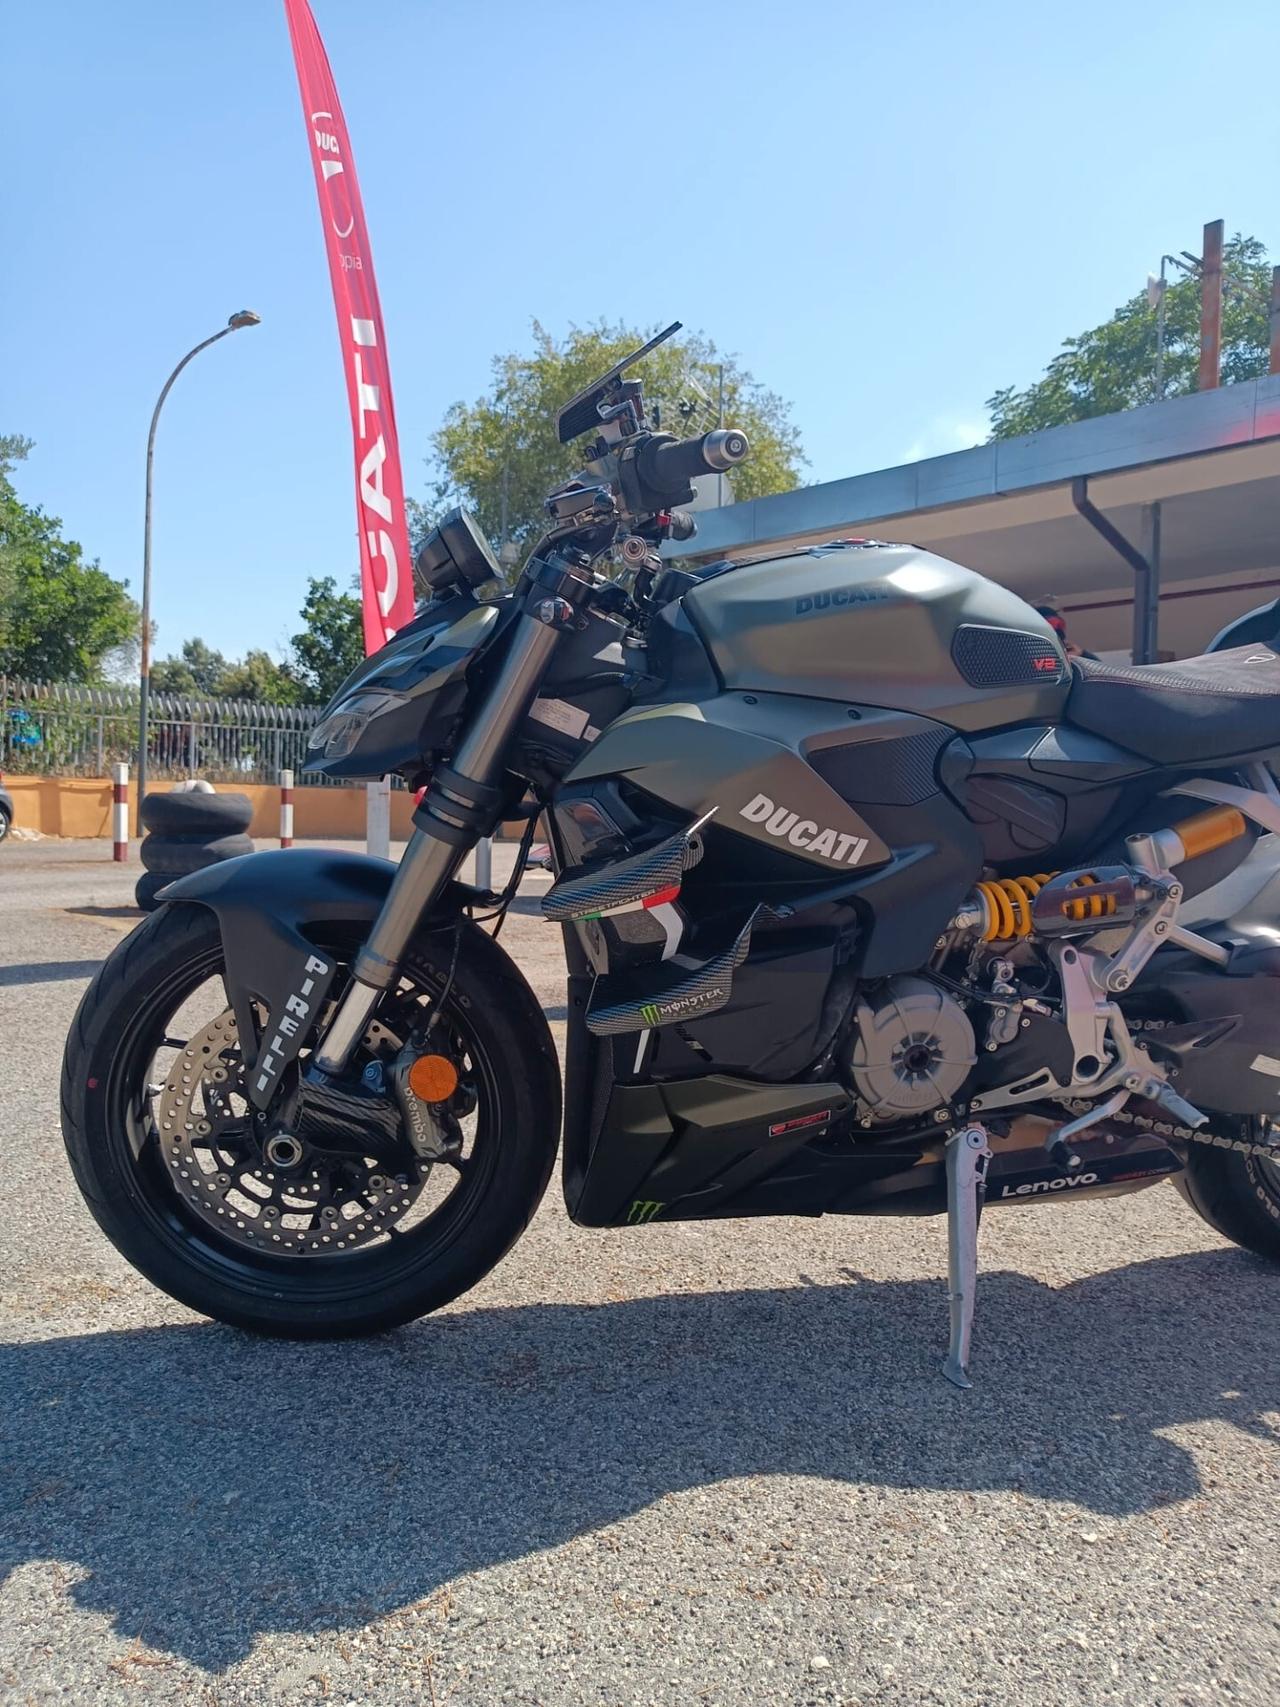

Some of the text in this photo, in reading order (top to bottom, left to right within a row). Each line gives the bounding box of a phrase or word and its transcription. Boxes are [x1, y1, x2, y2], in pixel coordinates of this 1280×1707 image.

[350, 313, 399, 643] CATI
[739, 793, 869, 865] DUCATI
[257, 955, 329, 1092] PIRELLI
[659, 987, 724, 1015] MONSTER
[403, 1087, 427, 1142] brembo
[1002, 1173, 1098, 1197] Lenovo
